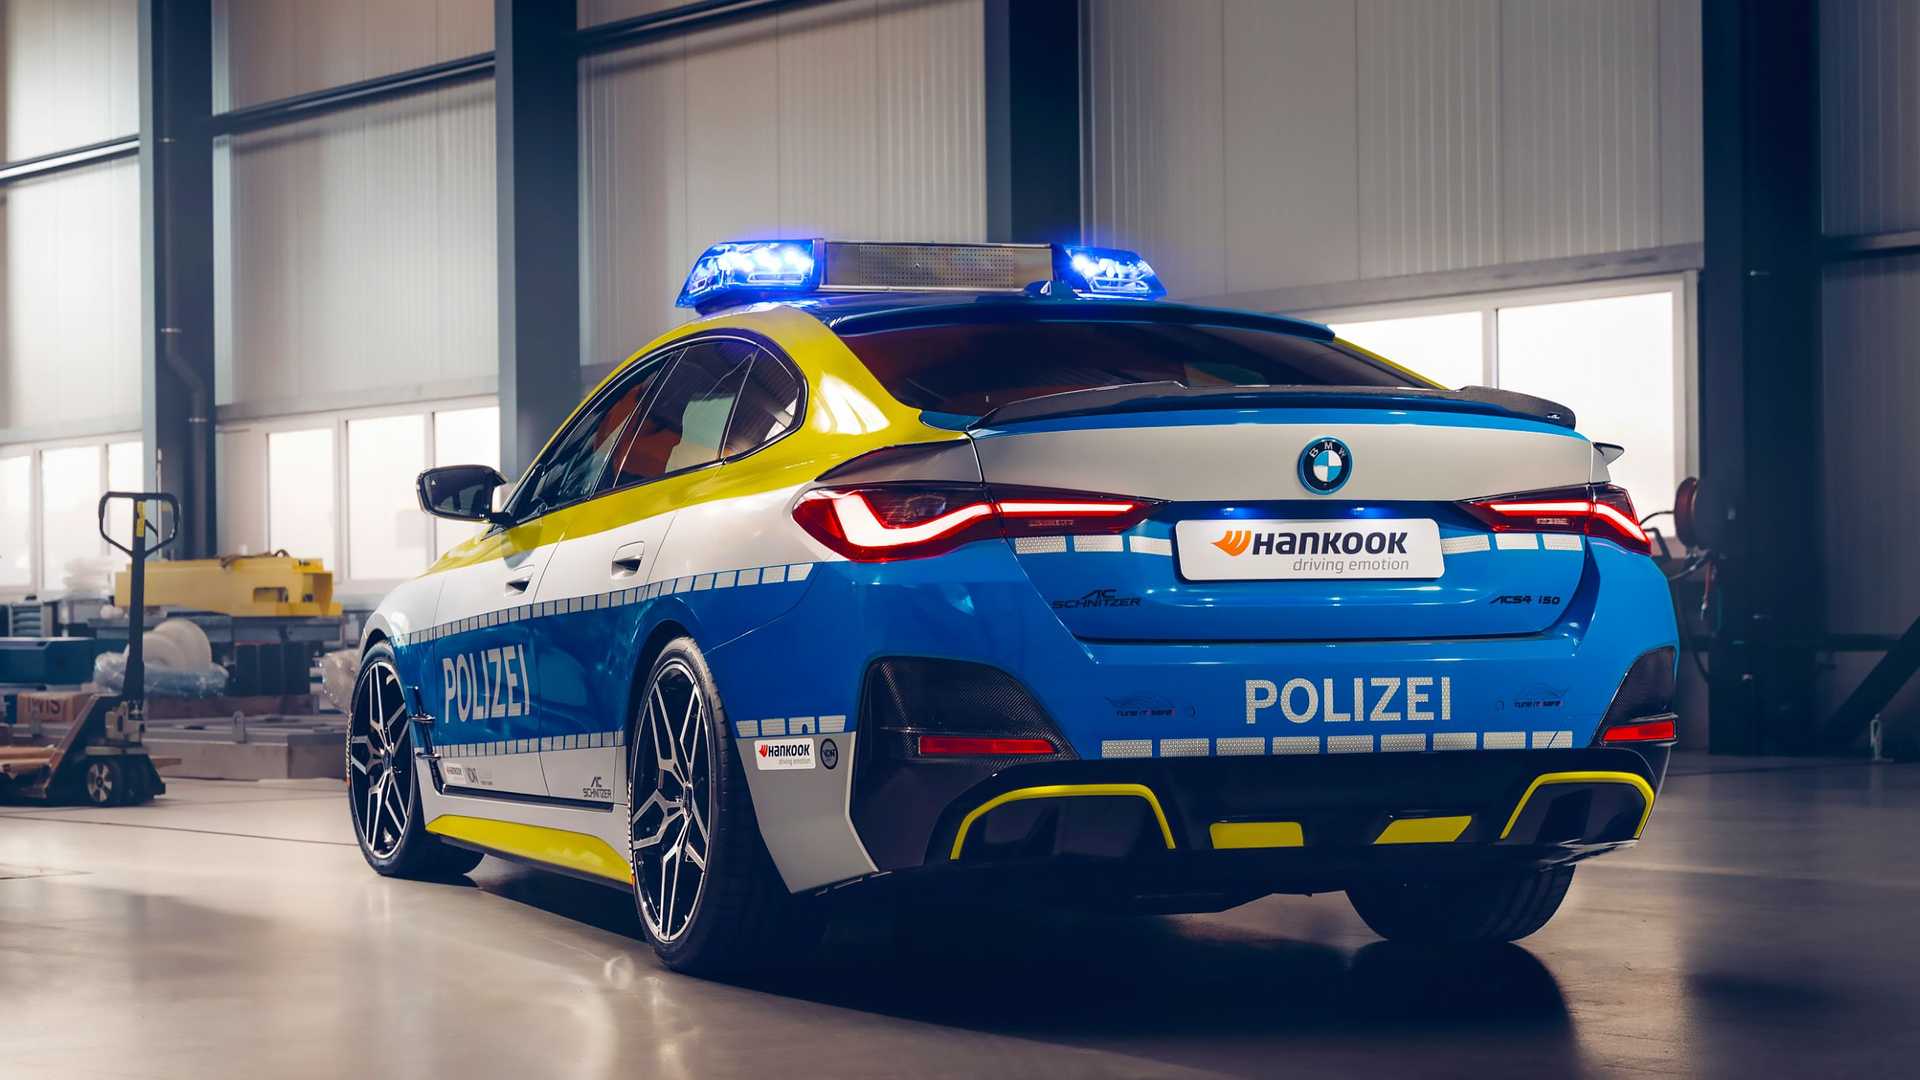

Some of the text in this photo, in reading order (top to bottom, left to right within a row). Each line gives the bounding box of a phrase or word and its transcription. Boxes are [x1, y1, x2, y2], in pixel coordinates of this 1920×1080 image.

[1309, 442, 1346, 458] BMW
[1293, 557, 1409, 574] driving emotion
[1080, 588, 1118, 600] AC
[1051, 597, 1142, 609] SCHNITZER
[442, 643, 530, 724] POLIZEI
[1245, 676, 1451, 725] POLIZEI
